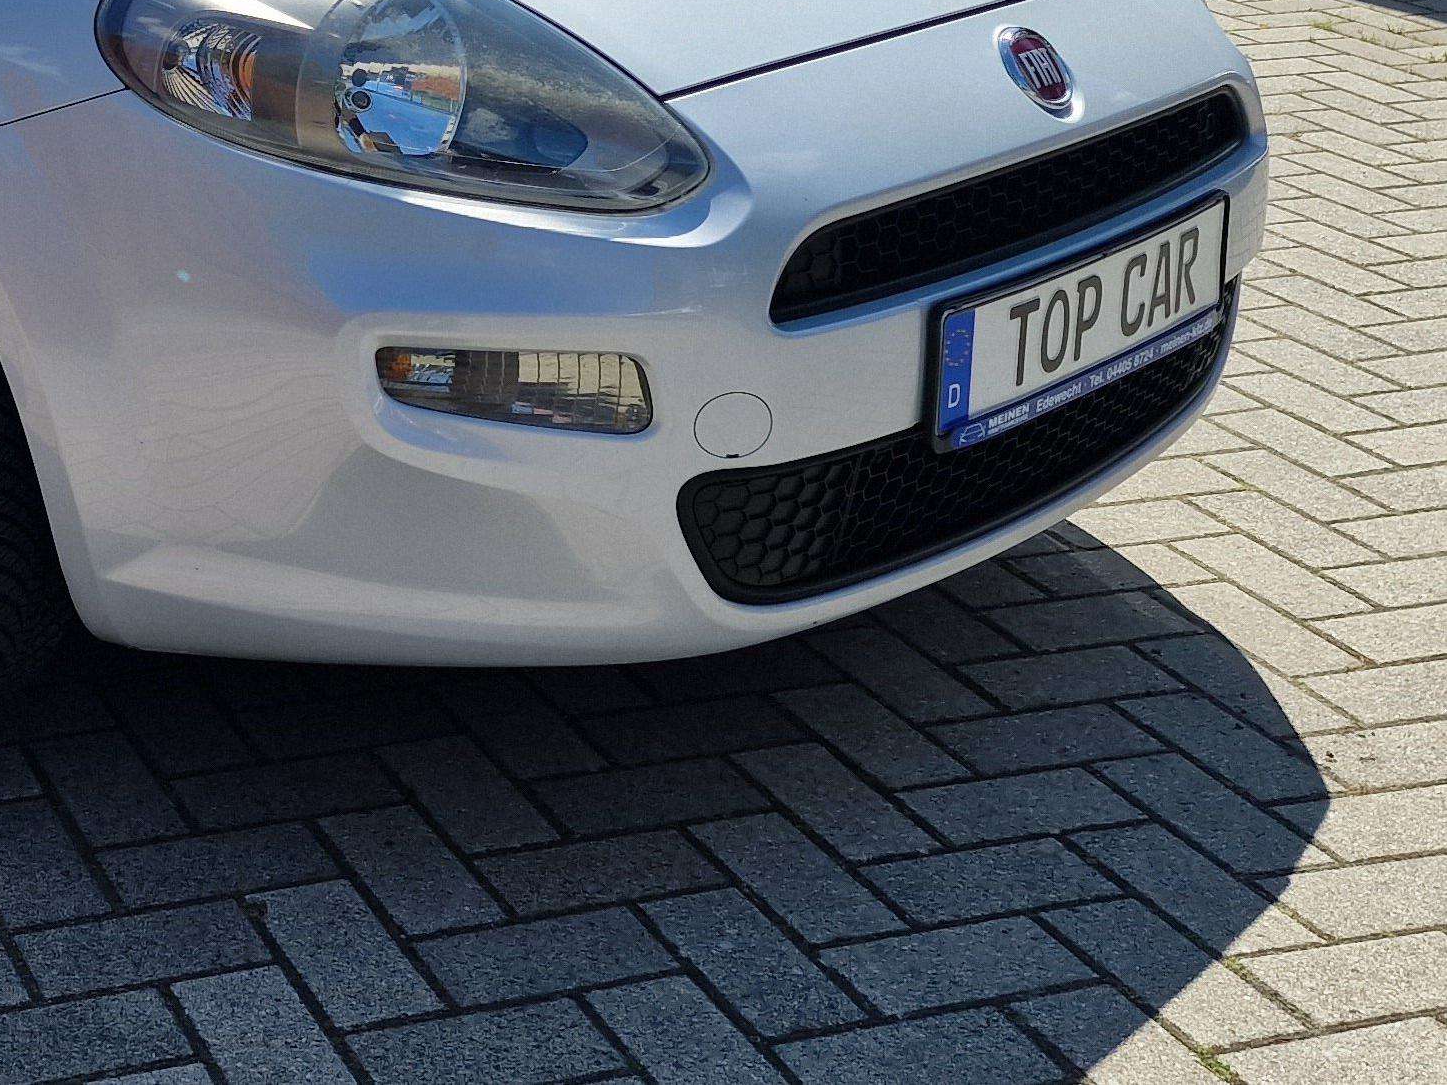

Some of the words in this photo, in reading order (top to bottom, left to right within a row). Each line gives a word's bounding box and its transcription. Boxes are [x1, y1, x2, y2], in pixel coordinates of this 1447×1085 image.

[1017, 47, 1062, 89] FIAT
[1009, 275, 1102, 387] TOP
[1120, 227, 1200, 337] CAR
[947, 383, 961, 408] D
[988, 403, 1030, 429] MEINEN
